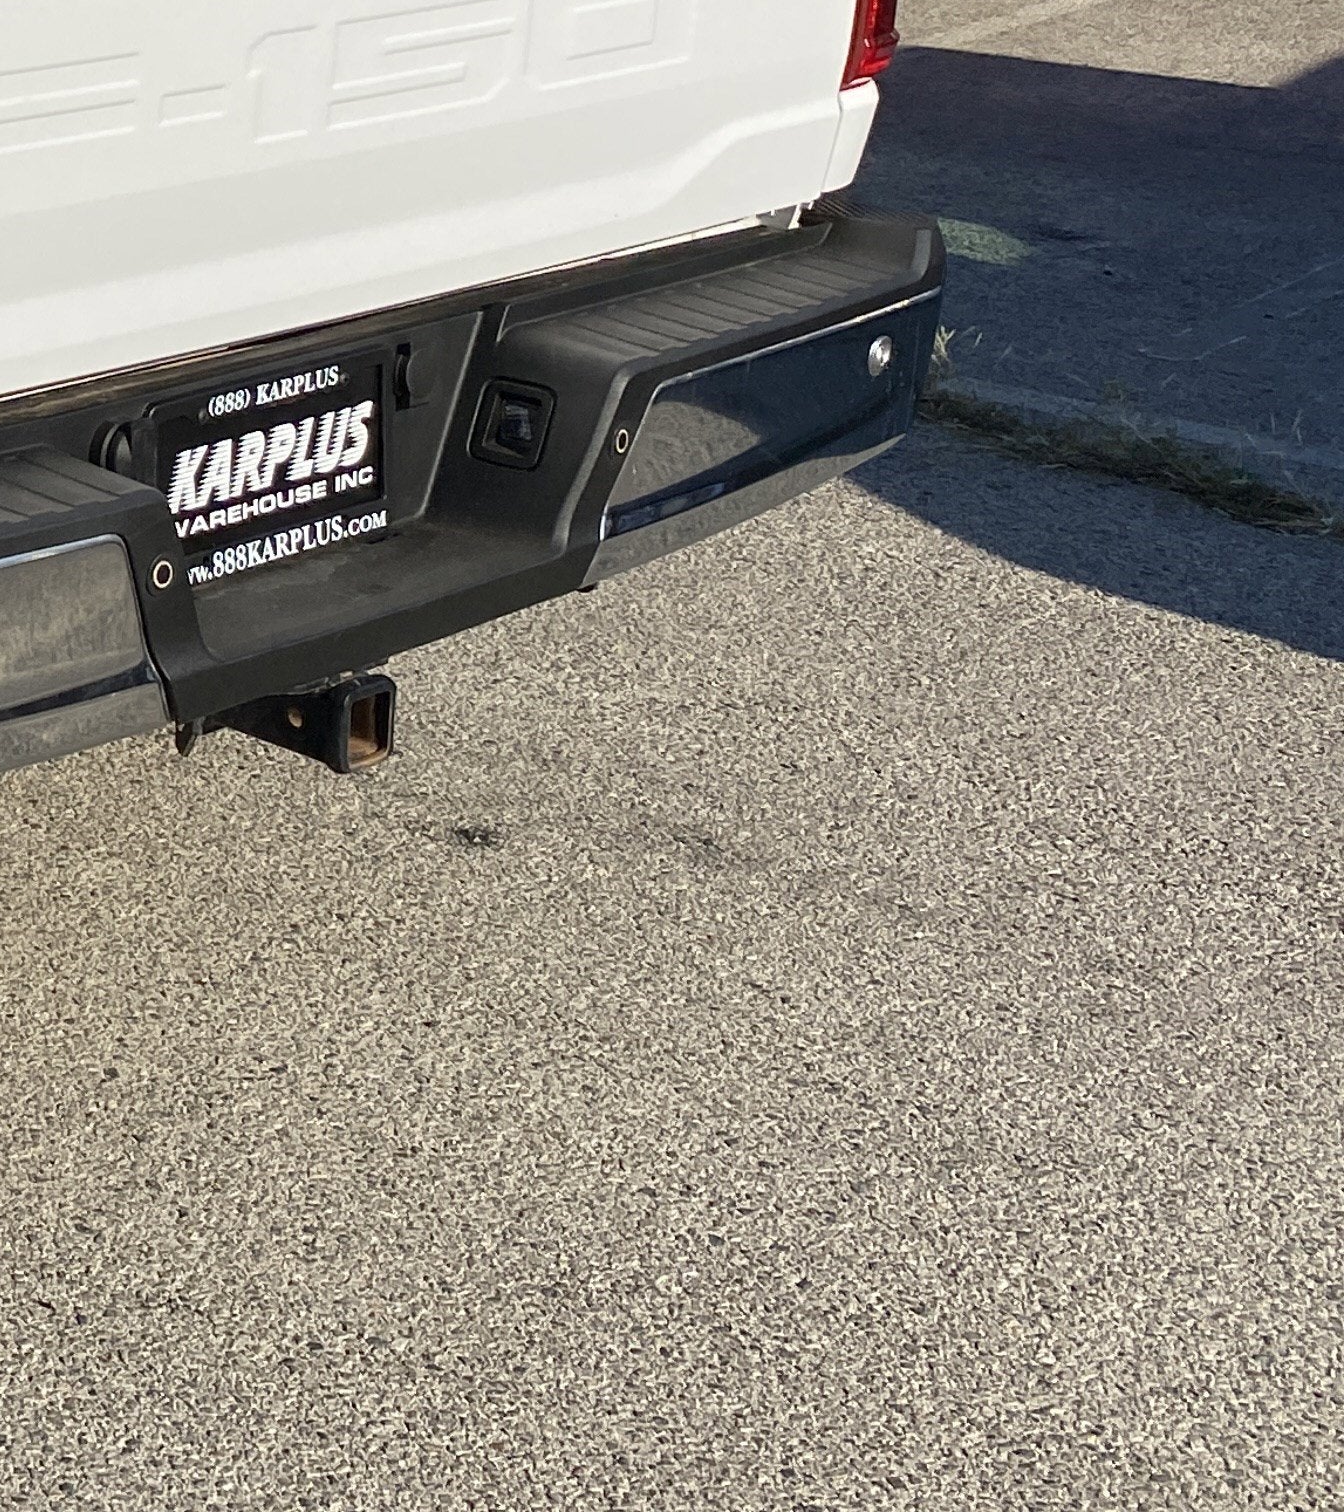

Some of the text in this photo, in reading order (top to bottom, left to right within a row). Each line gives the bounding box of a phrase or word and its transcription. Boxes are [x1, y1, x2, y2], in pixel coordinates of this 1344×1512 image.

[208, 364, 340, 417] (888) KARPLUS
[166, 399, 375, 515] KARPLUS
[334, 465, 375, 493] INC
